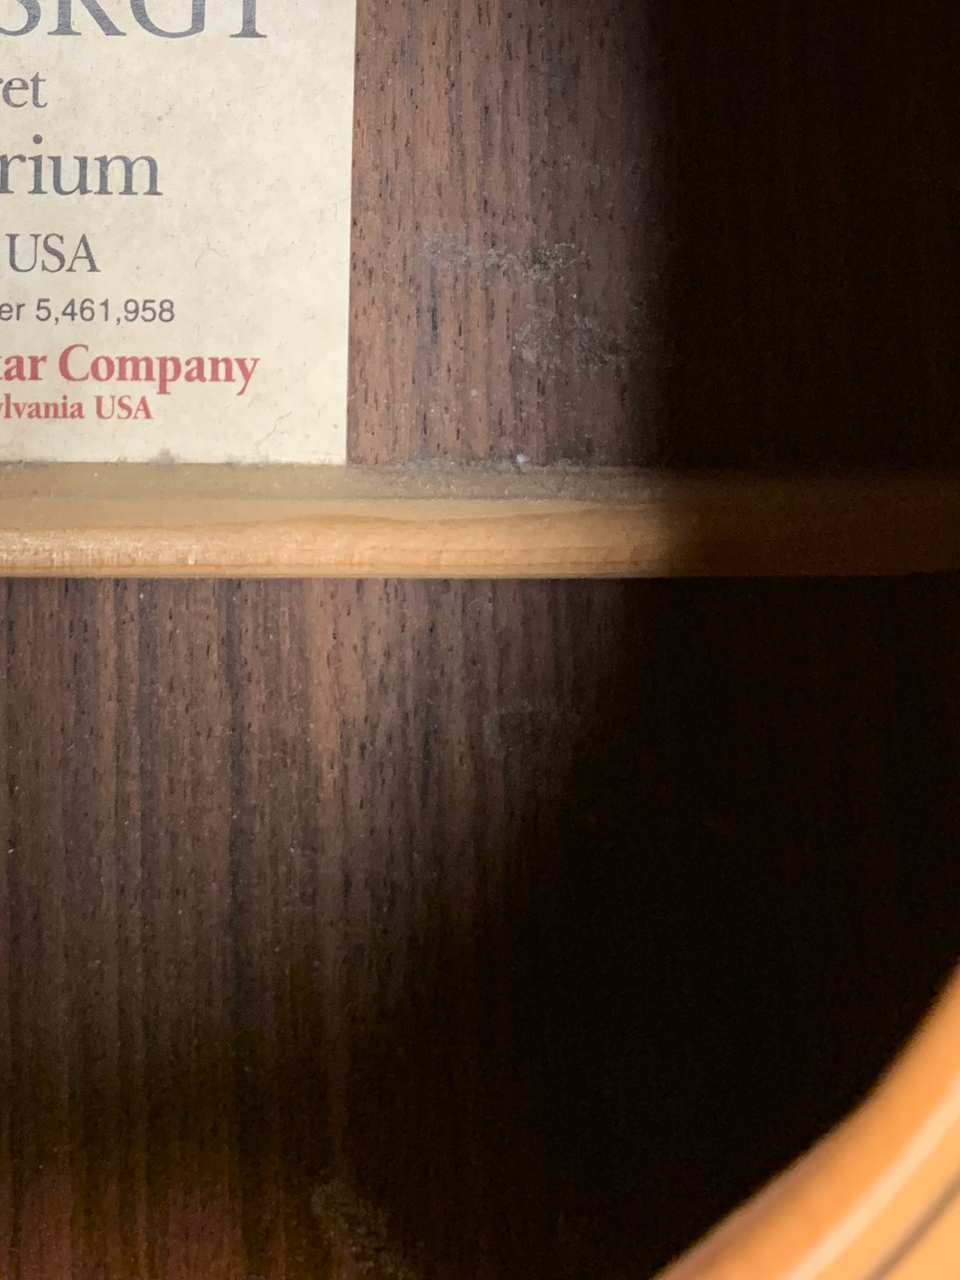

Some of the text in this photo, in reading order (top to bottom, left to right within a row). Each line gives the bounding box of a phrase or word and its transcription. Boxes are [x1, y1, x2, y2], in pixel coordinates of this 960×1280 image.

[5, 233, 102, 273] USA
[36, 298, 176, 326] 5,461,958
[59, 344, 261, 395] Company
[95, 396, 153, 420] USA
